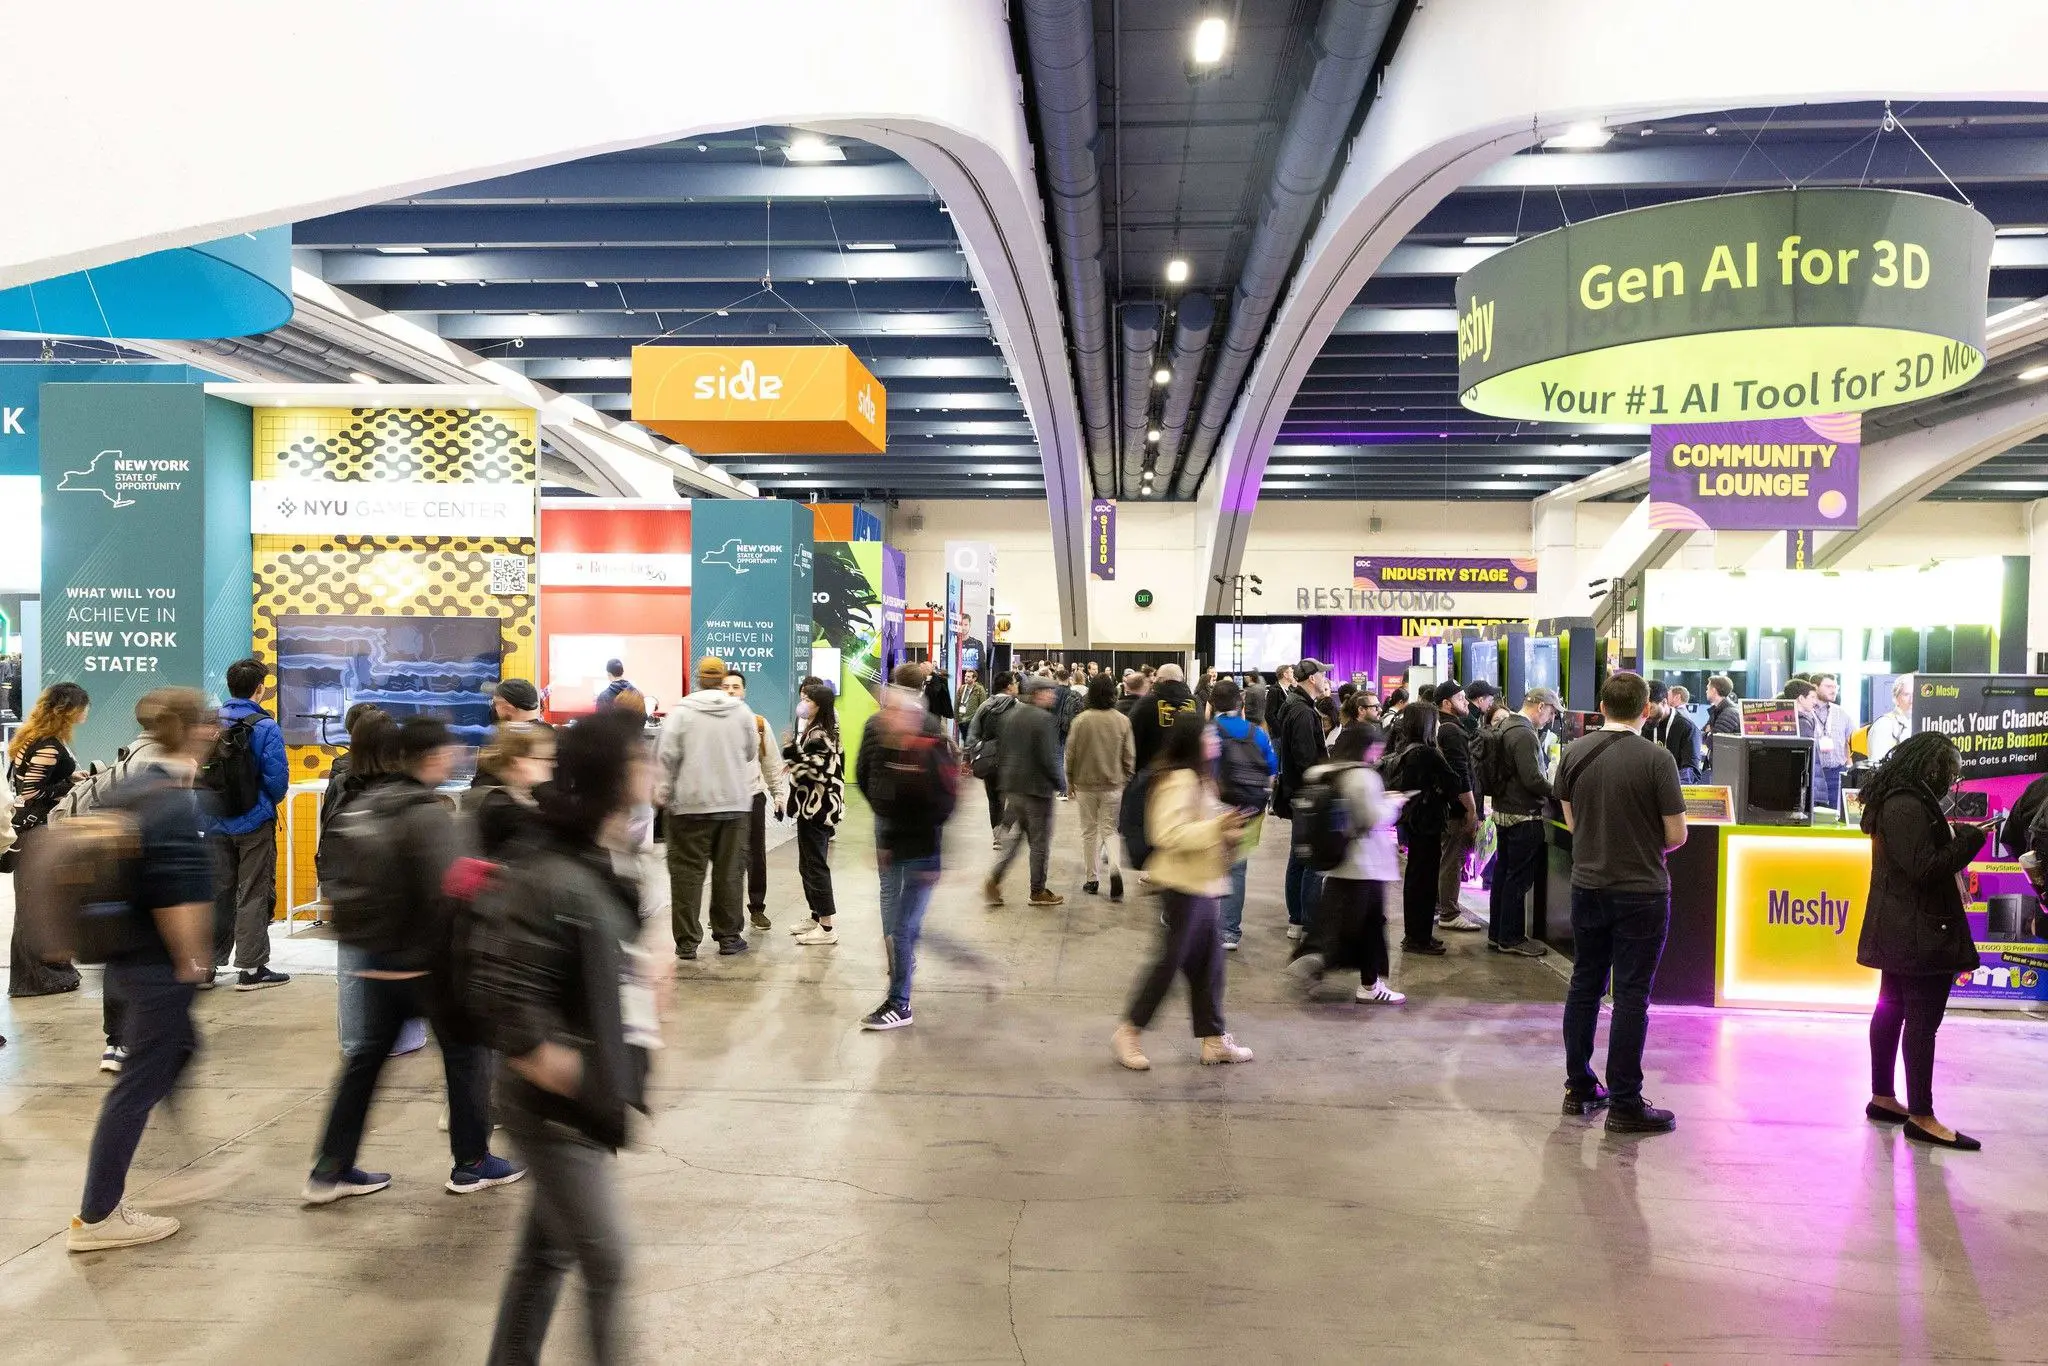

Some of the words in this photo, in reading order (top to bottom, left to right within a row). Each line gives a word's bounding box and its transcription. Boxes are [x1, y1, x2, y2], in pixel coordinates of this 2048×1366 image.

[1579, 260, 1685, 310] Gen
[1700, 242, 1758, 293] AI
[1777, 235, 1860, 286] for
[1871, 240, 1930, 290] 3D
[1458, 295, 1495, 364] eshy
[694, 359, 784, 401] side
[1540, 381, 1616, 414] Your
[1625, 384, 1669, 415] #1
[1680, 382, 1719, 414] AI
[1733, 371, 1820, 411] Tool
[1831, 366, 1886, 403] for
[1894, 353, 1934, 393] 3D
[857, 383, 876, 425] side
[1672, 443, 1838, 468] COMMUNITY
[114, 459, 148, 471] NEW
[149, 459, 190, 472] YORK
[114, 473, 143, 482] STATE
[144, 473, 158, 482] OF
[1699, 473, 1810, 497] LOUNGE
[114, 482, 182, 491] OPPORTUNITY
[303, 500, 348, 516] NYU
[423, 501, 507, 518] CENTER
[1099, 514, 1108, 565] S1500
[736, 544, 757, 553] NEW
[757, 544, 783, 553] YORK
[1382, 567, 1457, 582] INDUSTRY
[1459, 568, 1509, 583] STAGE
[66, 587, 107, 599] WHAT
[110, 587, 142, 599] WILL
[146, 588, 176, 599] YOU
[1138, 594, 1150, 603] EXIT
[1296, 587, 1456, 610] RESTROOMS
[66, 607, 150, 623] ACHIEVE
[157, 607, 176, 623] IN
[706, 620, 731, 629] WHAT
[733, 621, 753, 629] WILL
[755, 621, 774, 629] YOU
[66, 631, 113, 647] NEW
[120, 631, 177, 648] YORK
[706, 632, 757, 643] ACHIEVE
[761, 633, 773, 643] IN
[705, 646, 735, 657] NEW
[739, 647, 774, 658] YORK
[84, 656, 159, 672] STATE?
[725, 661, 763, 673] TATE?
[1935, 685, 1960, 699] Meshy
[1921, 714, 1965, 735] Unlock
[1968, 712, 1999, 732] Your
[2002, 709, 2048, 729] Chance
[1974, 734, 2004, 752] Prize
[1960, 757, 1977, 767] one
[1979, 756, 1999, 765] Gets
[2001, 755, 2007, 763] a
[2009, 752, 2037, 763] Piece!
[1985, 864, 2022, 872] PlayStation
[1768, 889, 1850, 935] Meshy
